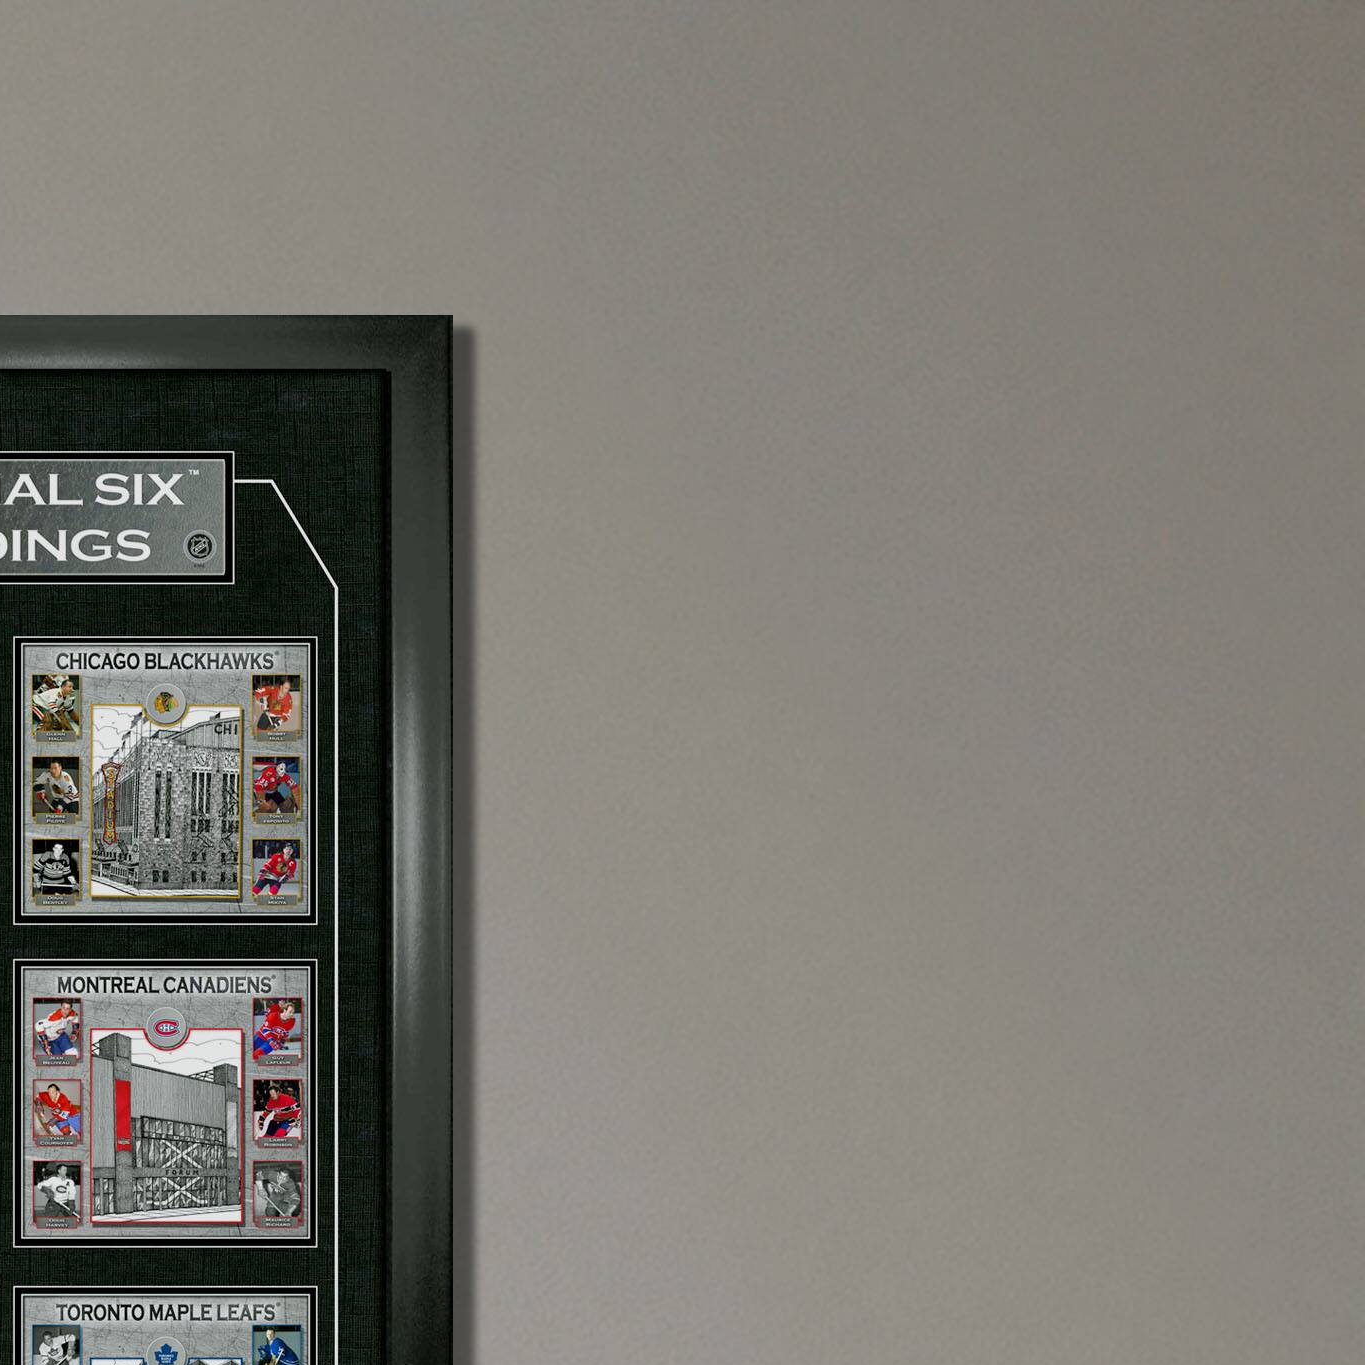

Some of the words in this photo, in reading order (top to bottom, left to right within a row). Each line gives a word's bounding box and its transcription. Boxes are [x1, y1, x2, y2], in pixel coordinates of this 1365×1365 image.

[95, 473, 184, 506] SIX
[56, 652, 139, 670] CHICAGO
[145, 652, 274, 670] BLACKHAWKS
[214, 723, 238, 735] CHI
[57, 976, 159, 994] MONTREAL
[163, 976, 271, 994] CANADIENS
[56, 1303, 144, 1321] TORONTO
[150, 1303, 212, 1321] MAPLE
[217, 1303, 275, 1321] LEAFS
